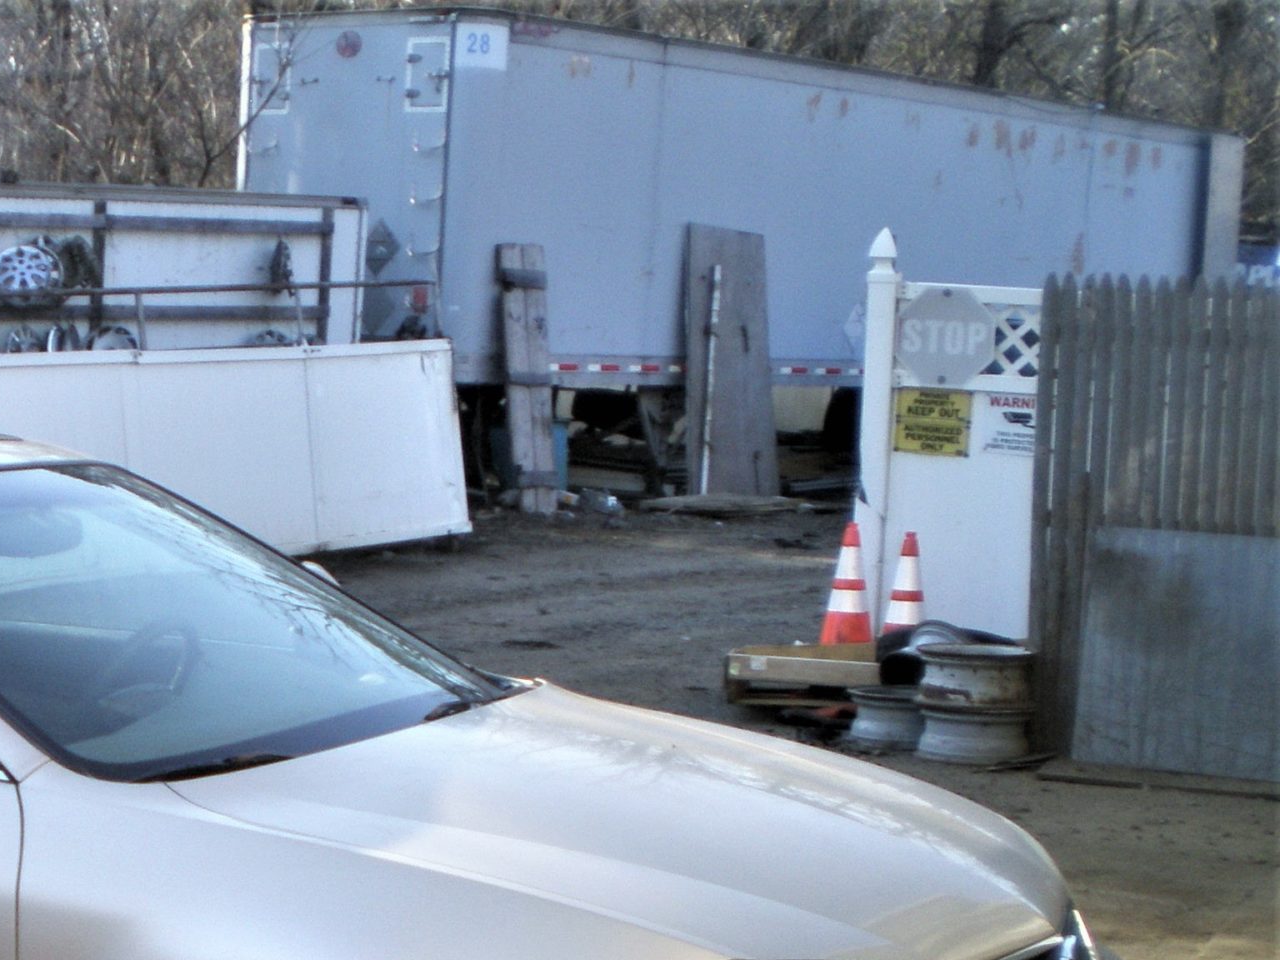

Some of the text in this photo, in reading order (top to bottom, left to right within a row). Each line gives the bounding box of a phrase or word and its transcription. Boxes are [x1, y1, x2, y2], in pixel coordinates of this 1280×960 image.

[467, 32, 490, 54] 28
[901, 319, 986, 354] STOP
[990, 396, 1035, 409] WARNI
[907, 405, 960, 418] KEEP OUT
[904, 424, 962, 436] AUTHORIZED
[905, 432, 961, 444] PERSONNEL
[921, 442, 944, 452] ONLY
